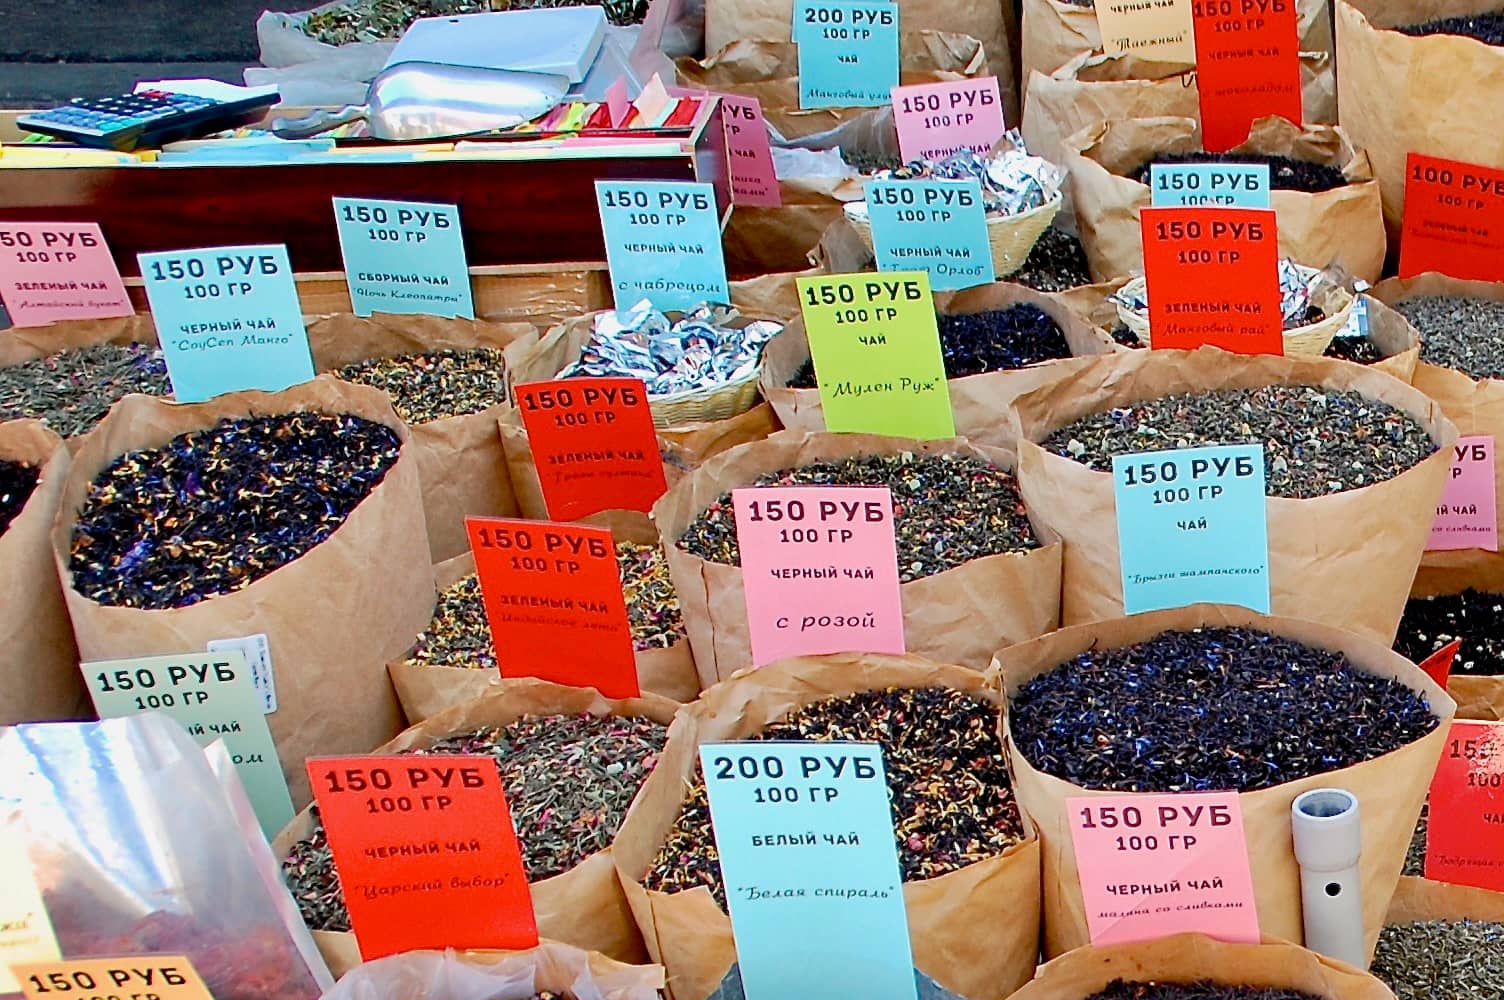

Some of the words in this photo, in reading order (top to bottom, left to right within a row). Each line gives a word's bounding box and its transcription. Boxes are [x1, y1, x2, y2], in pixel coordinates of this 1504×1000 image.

[805, 7, 843, 24] 200
[852, 9, 893, 25] РУБ
[1110, 1, 1152, 15] ЧЕРНЫЙ
[1154, 0, 1174, 9] ЧАЙ
[1214, 19, 1242, 33] 100
[1246, 18, 1265, 31] ГР
[902, 94, 940, 114] 150
[949, 88, 994, 109] РУБ
[1158, 172, 1200, 191] 150
[1210, 173, 1259, 191] РУБ
[1412, 165, 1454, 186] 100
[604, 190, 648, 208] 150
[658, 191, 709, 210] РУБ
[890, 245, 942, 257] ЧЕРНЫЙ
[945, 247, 970, 259] ЧАЙ
[151, 258, 204, 281] 150
[216, 255, 278, 276] РУБ
[358, 272, 411, 283] СБОРНЫЙ
[422, 275, 449, 286] ЧАЙ
[618, 281, 628, 291] с
[806, 284, 855, 306] 150
[865, 281, 922, 302] РУБ
[1165, 302, 1230, 314] ЗЕЛЕНЫЙ
[1233, 302, 1262, 314] ЧАЙ
[899, 377, 940, 395] Руж"
[524, 389, 574, 411] 150
[583, 387, 639, 406] РУБ
[1153, 487, 1190, 504] 100
[1198, 485, 1223, 500] ГР
[748, 500, 805, 522] 150
[819, 501, 884, 522] РУБ
[510, 555, 548, 572] 100
[554, 559, 580, 575] ГР
[776, 617, 789, 629] с
[800, 612, 875, 632] розой
[97, 668, 156, 692] 150
[167, 662, 235, 686] РУБ
[325, 768, 393, 793] 150
[407, 767, 484, 789] РУБ
[751, 831, 812, 847] БЕЛЫЙ
[823, 831, 860, 846] ЧАЙ
[737, 886, 805, 901] "Белая
[814, 885, 894, 900] спираль"
[29, 971, 97, 993] 150
[107, 967, 186, 988] РУБ
